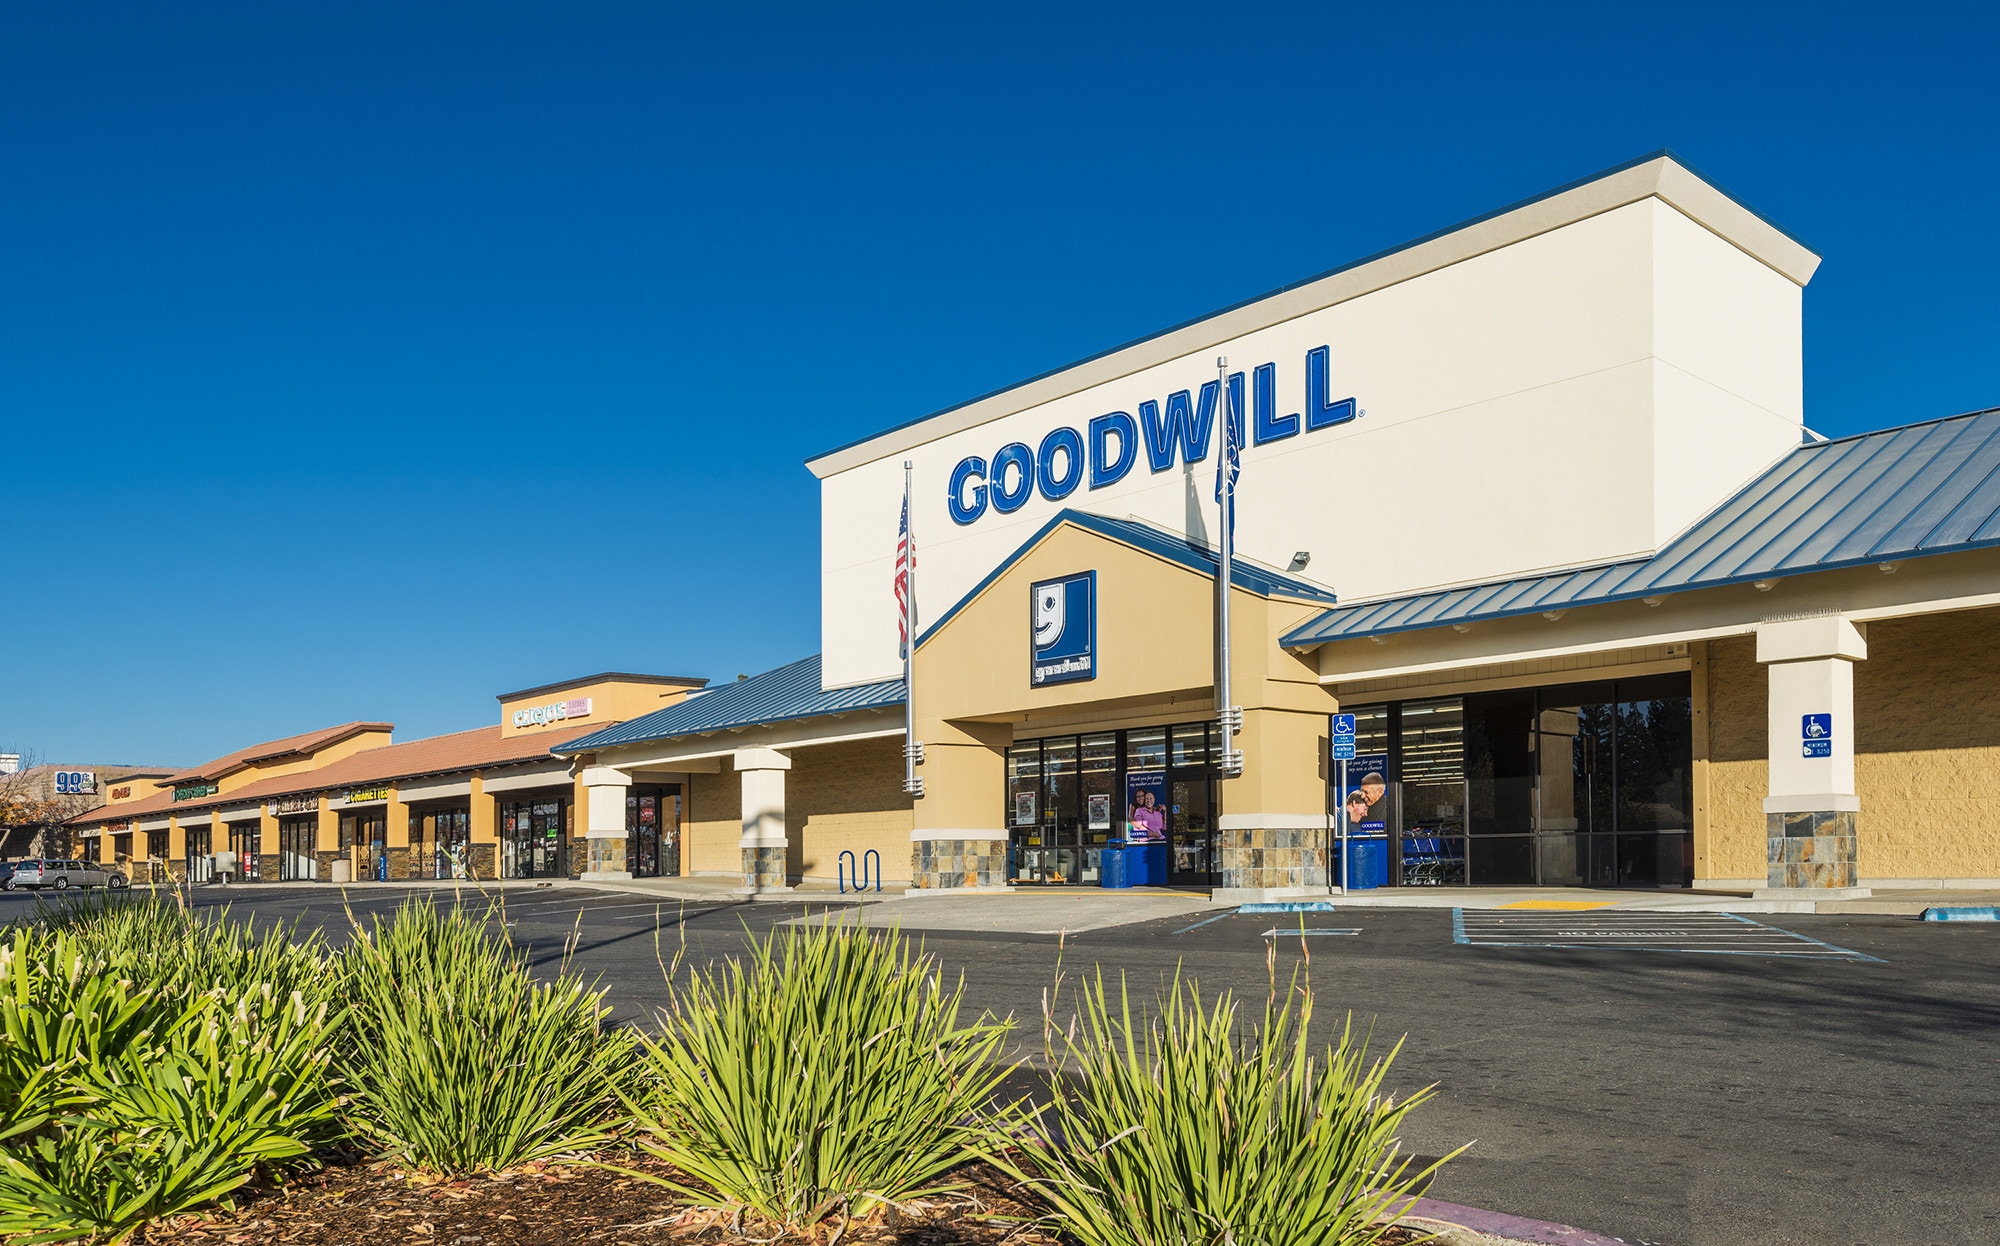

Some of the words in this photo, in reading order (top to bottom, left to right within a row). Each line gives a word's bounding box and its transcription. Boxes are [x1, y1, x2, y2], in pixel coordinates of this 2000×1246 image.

[947, 344, 1357, 526] GOODWILL
[1035, 655, 1091, 682] goodwill
[512, 702, 566, 727] CLIQUE
[350, 787, 389, 803] CIGARETTES
